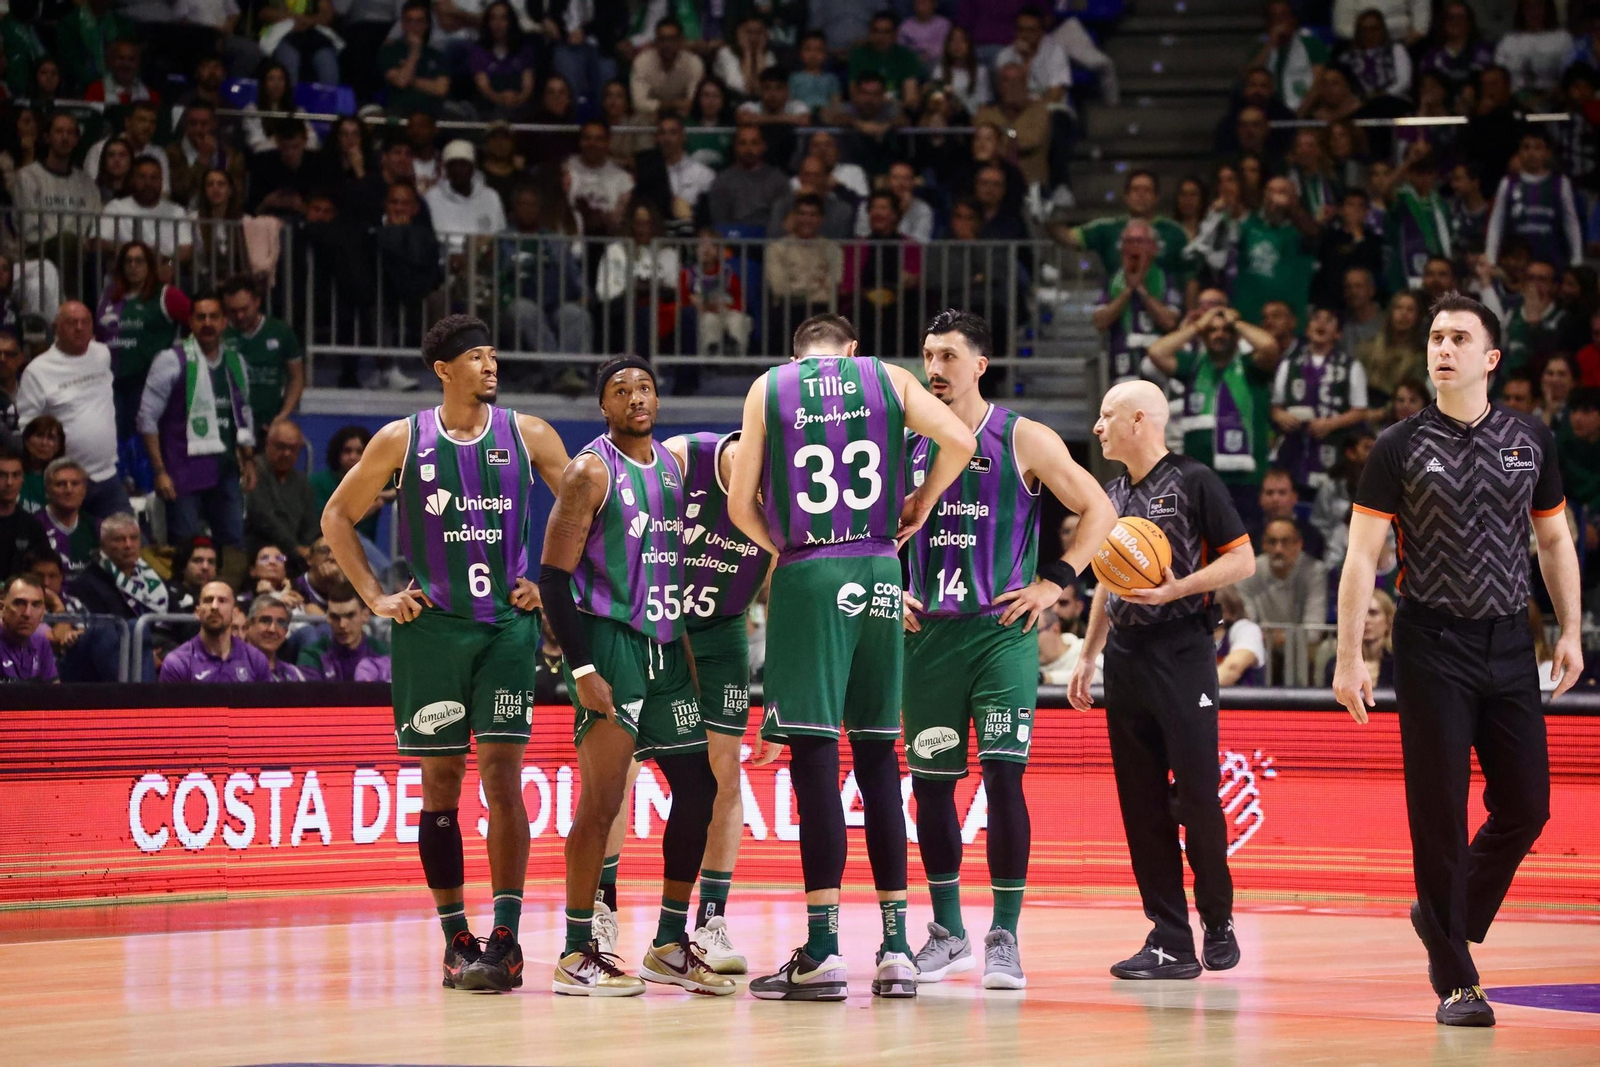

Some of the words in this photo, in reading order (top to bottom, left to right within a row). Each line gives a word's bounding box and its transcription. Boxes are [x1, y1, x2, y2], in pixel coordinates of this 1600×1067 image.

[803, 375, 857, 397] Tillie
[793, 439, 883, 515] 33
[455, 494, 512, 514] Unicaja
[704, 532, 759, 557] Unicaja
[1109, 523, 1151, 570] Wilson
[468, 562, 492, 598] 6
[936, 567, 969, 602] 14
[646, 584, 681, 622] 55
[869, 606, 900, 621] MÁLA
[871, 596, 893, 608] DEL
[493, 700, 522, 719] laga
[723, 694, 749, 713] laga
[673, 712, 702, 728] laga
[129, 770, 333, 851] COSTA
[352, 768, 423, 845] DE
